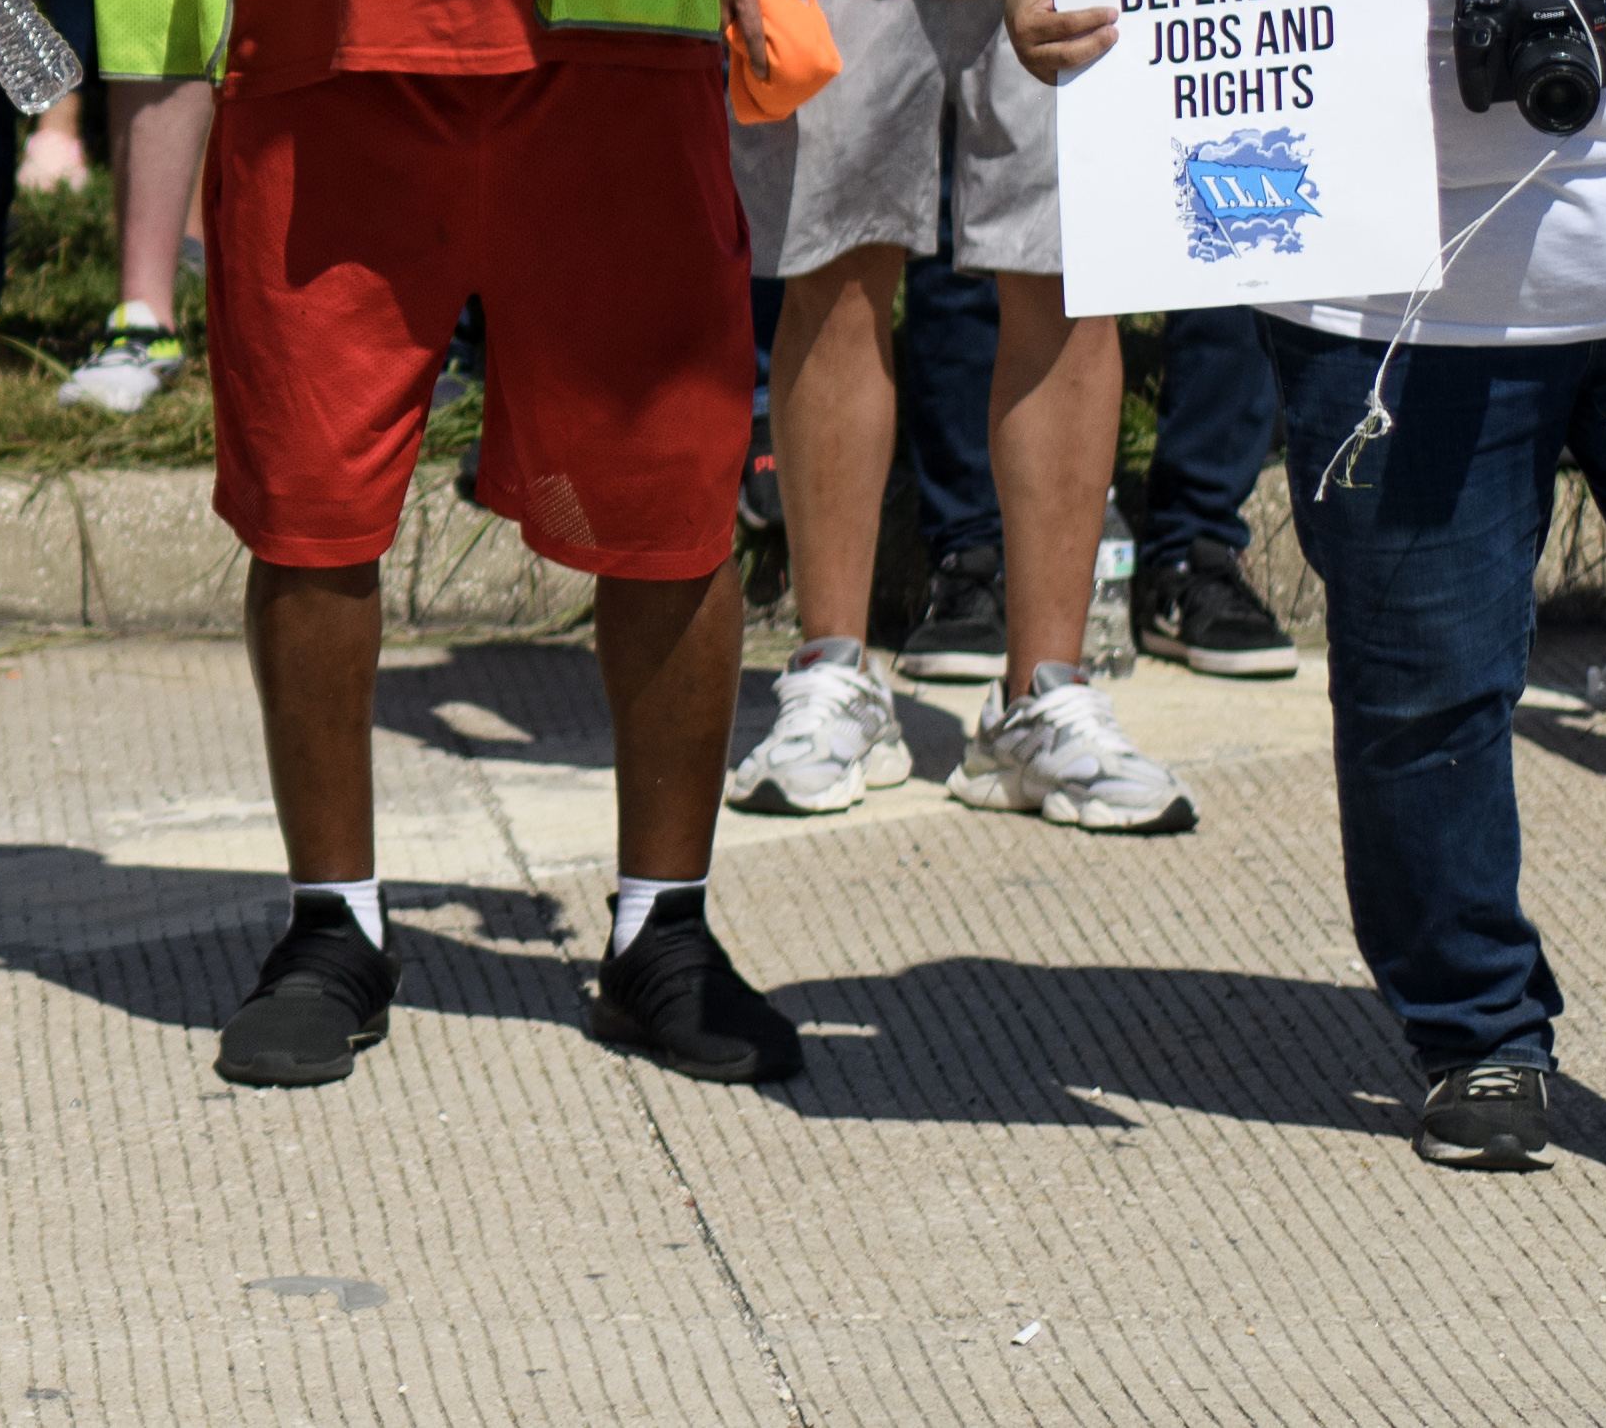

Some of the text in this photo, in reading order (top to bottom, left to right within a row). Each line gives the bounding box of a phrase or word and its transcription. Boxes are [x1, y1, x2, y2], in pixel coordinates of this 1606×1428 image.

[1147, 4, 1335, 67] JOBS AND
[1532, 10, 1566, 21] Canon
[1173, 63, 1314, 120] RIGHTS
[1198, 173, 1293, 210] I.L.A.
